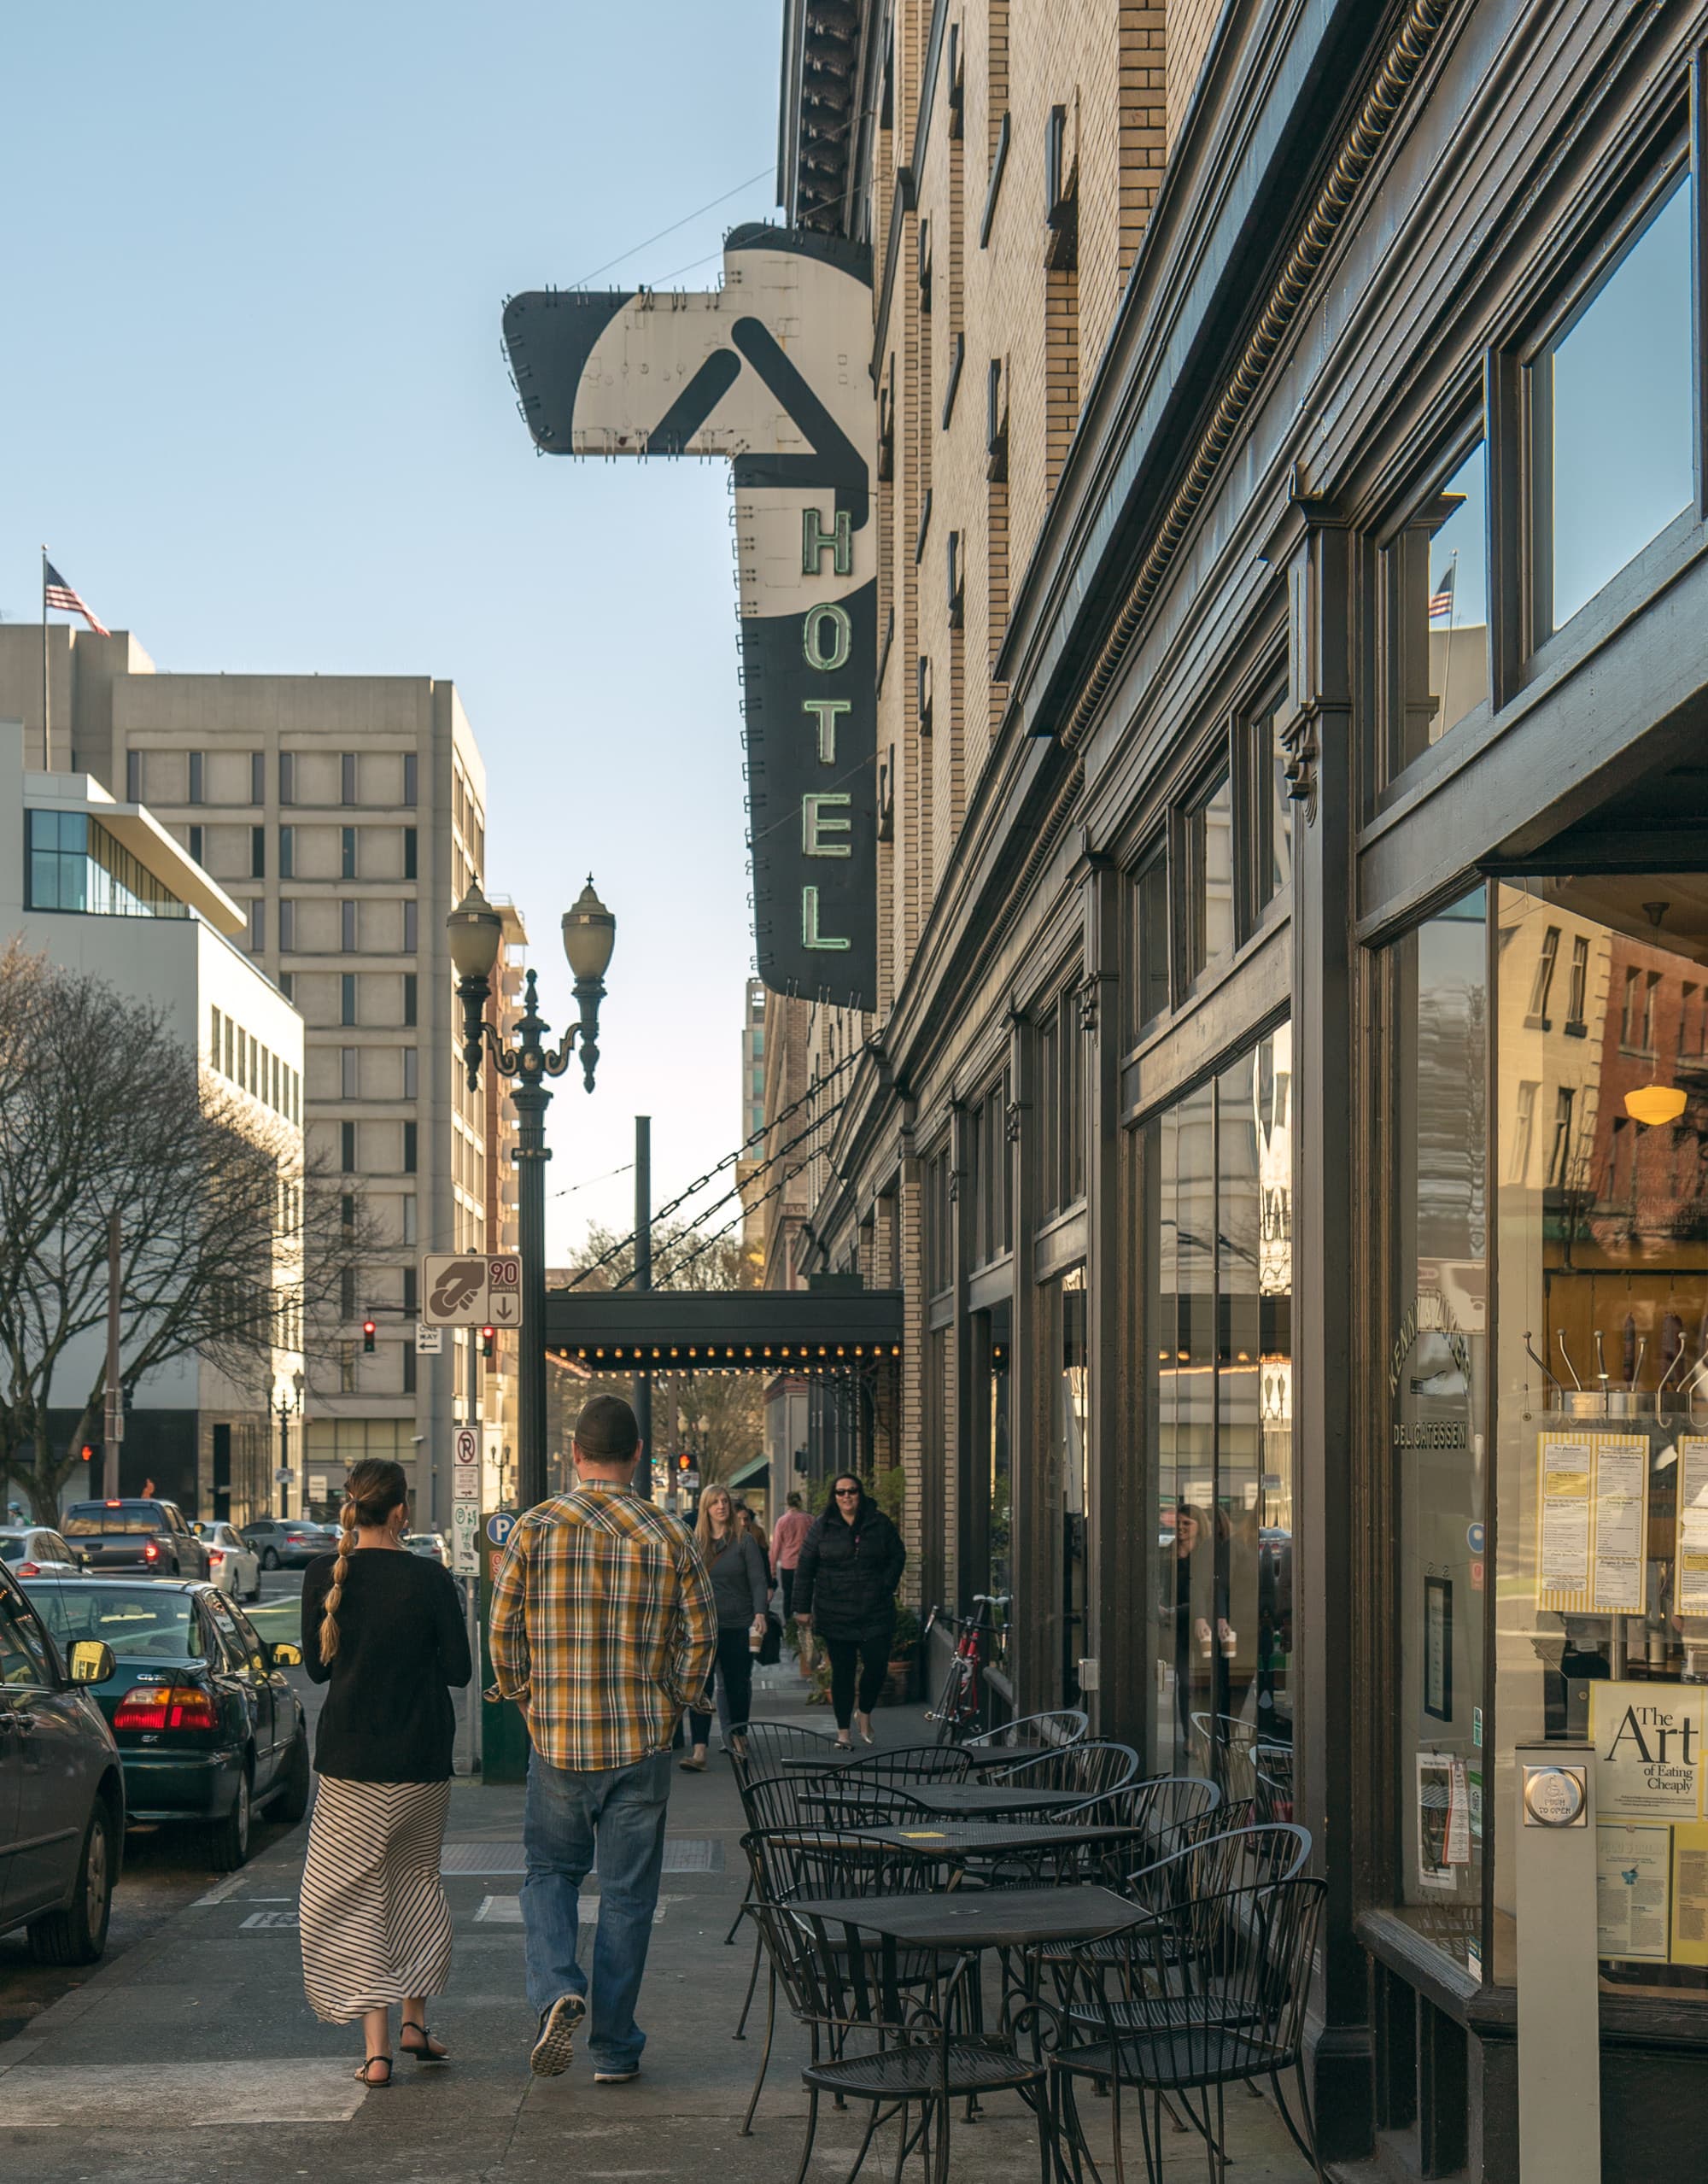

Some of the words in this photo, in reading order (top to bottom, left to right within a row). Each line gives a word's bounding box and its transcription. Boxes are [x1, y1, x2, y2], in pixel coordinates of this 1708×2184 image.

[801, 507, 852, 951] HOTEL
[489, 1261, 518, 1285] 90
[1393, 1421, 1466, 1449] DELICATESSEN
[496, 1519, 510, 1541] P
[1637, 1707, 1674, 1726] The
[1604, 1704, 1699, 1765] Art
[1644, 1765, 1655, 1777] of
[1658, 1765, 1693, 1781] Eating
[1647, 1777, 1693, 1794] Cheaply
